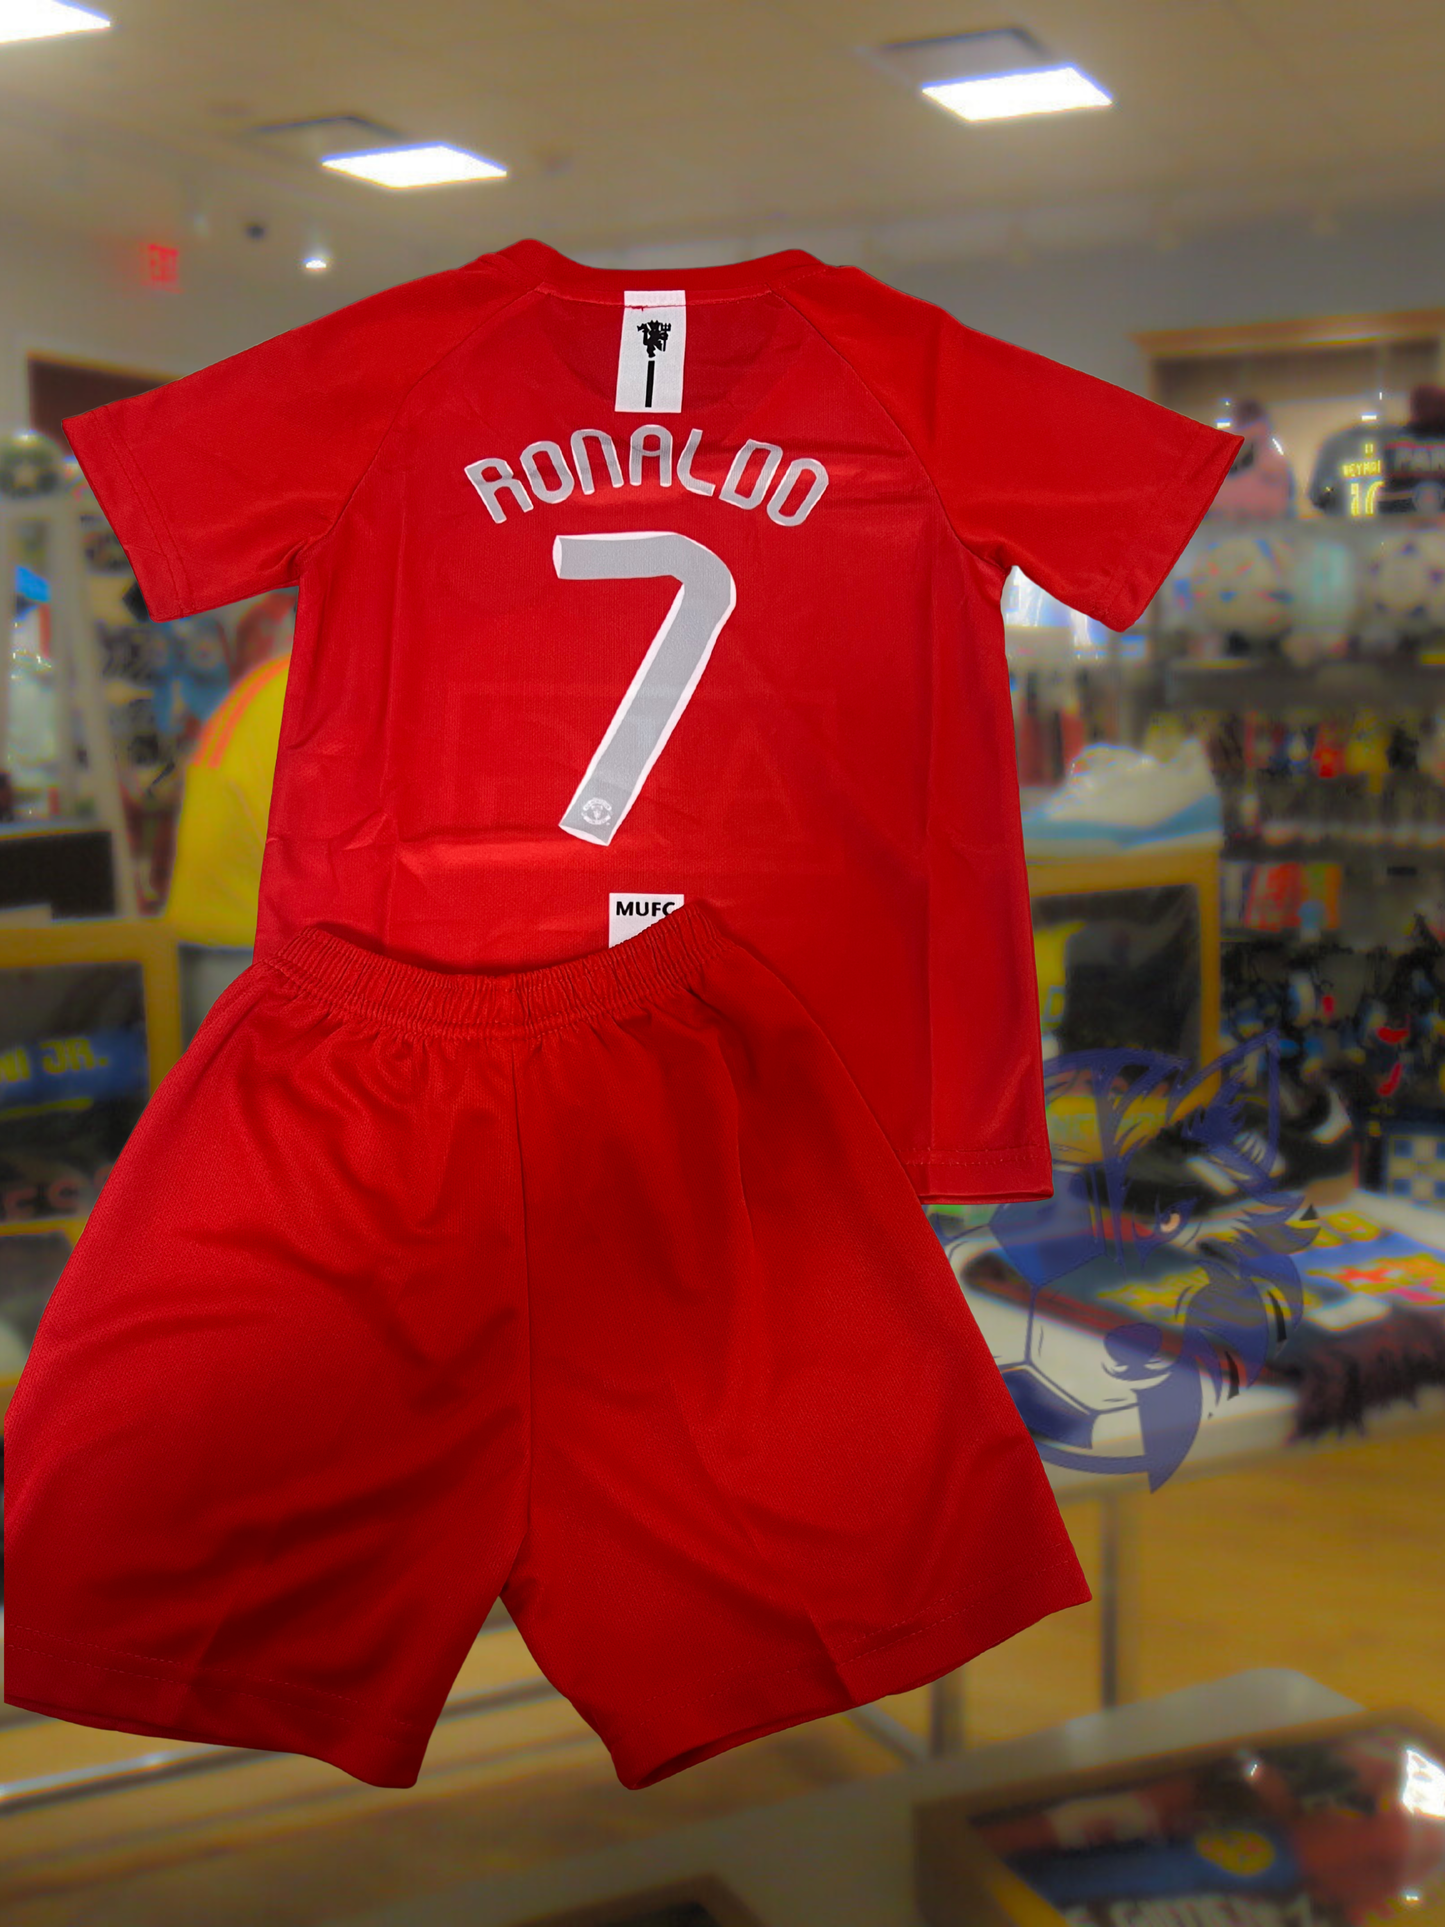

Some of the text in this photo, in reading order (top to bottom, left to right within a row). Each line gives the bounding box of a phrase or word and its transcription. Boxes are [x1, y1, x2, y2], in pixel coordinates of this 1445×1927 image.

[464, 424, 829, 526] RONALDO
[552, 530, 737, 846] 7
[616, 900, 676, 917] MUFC
